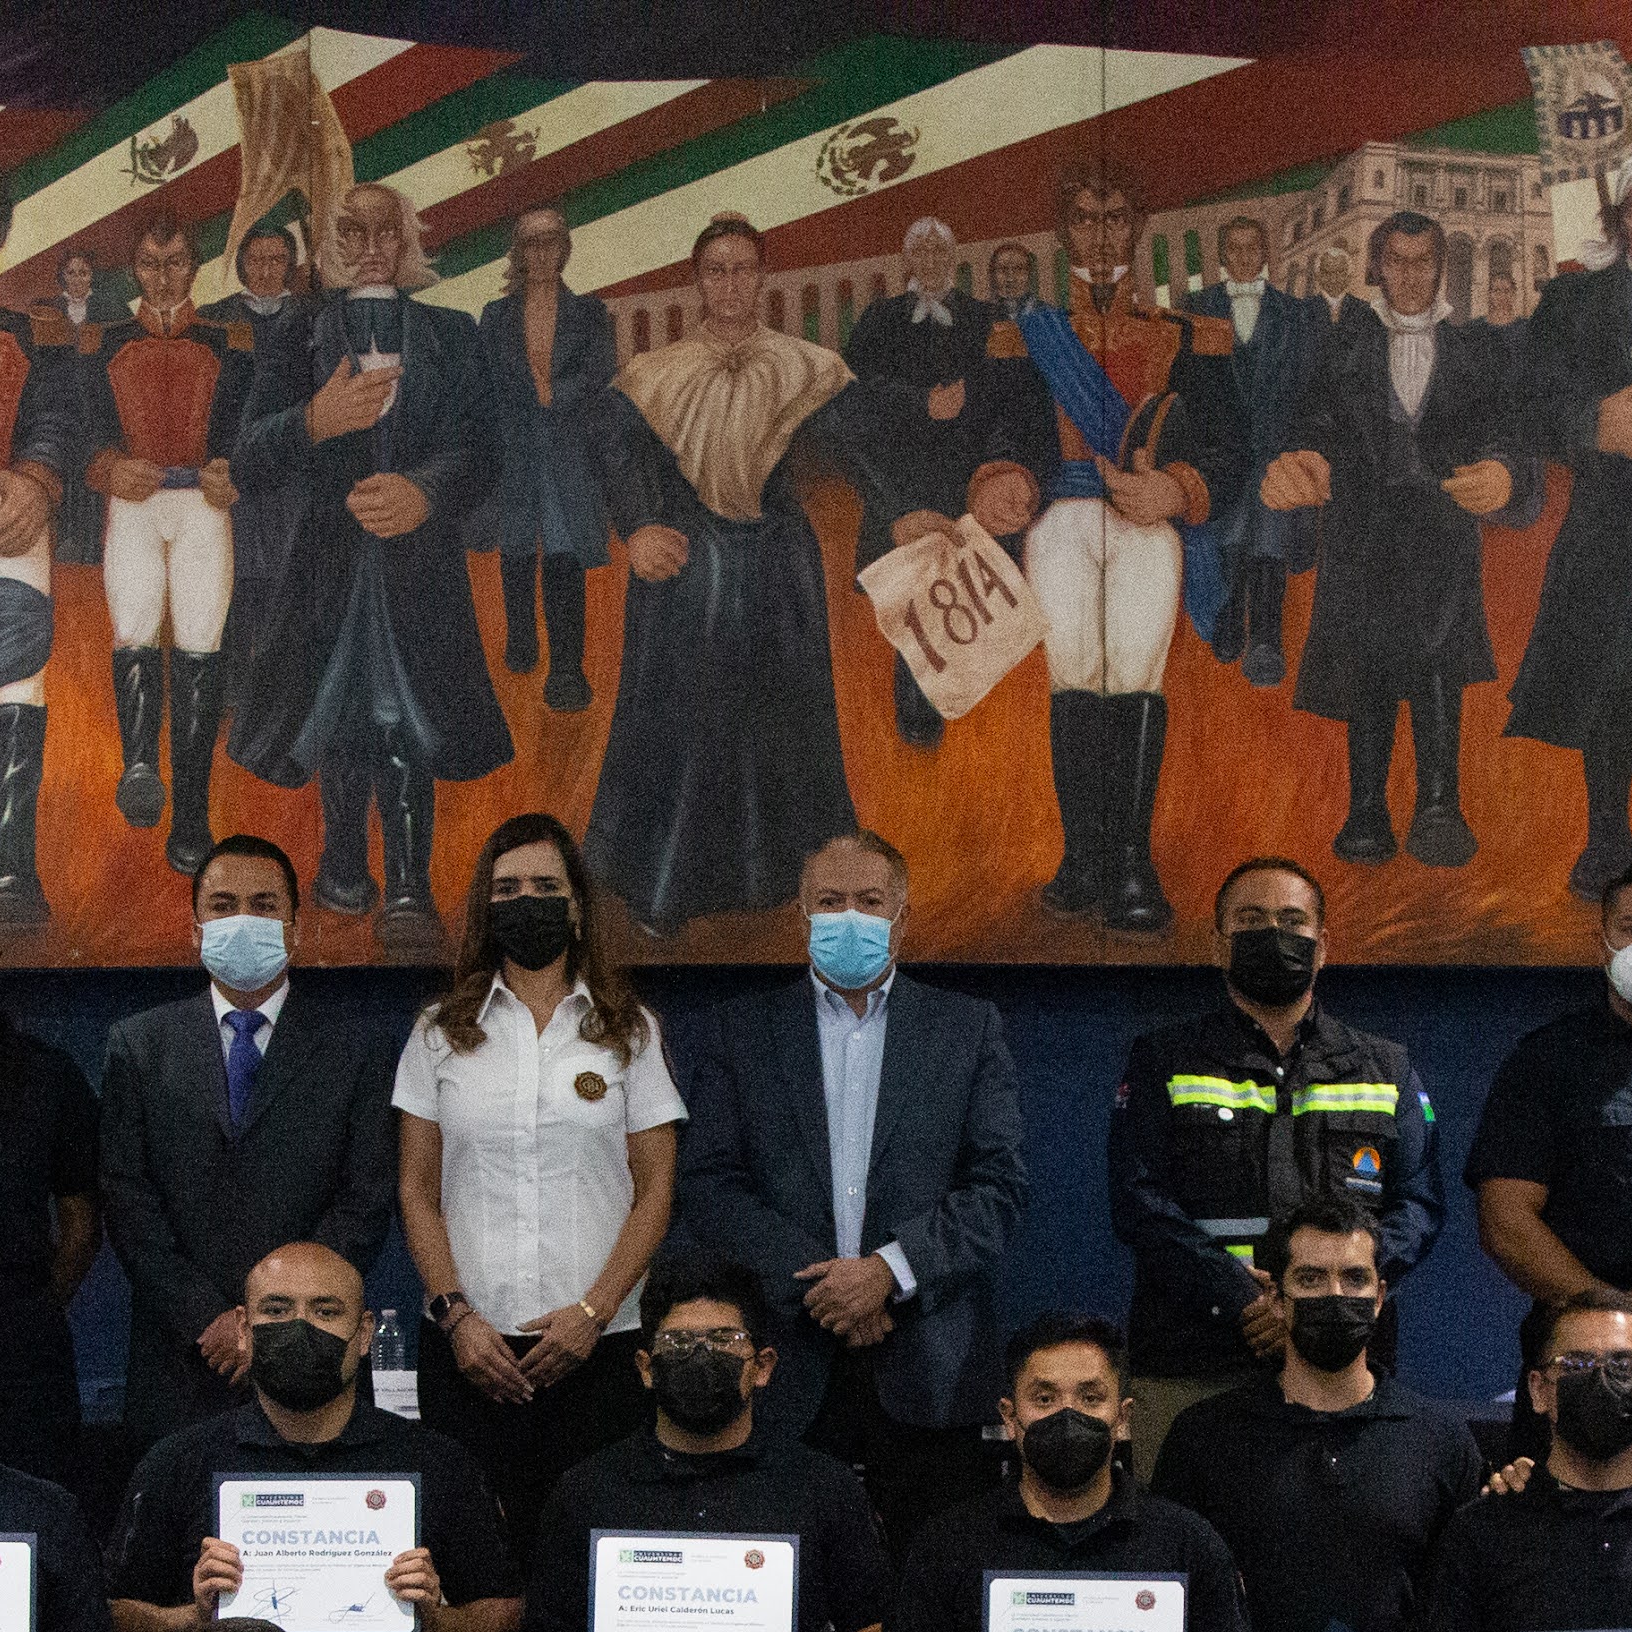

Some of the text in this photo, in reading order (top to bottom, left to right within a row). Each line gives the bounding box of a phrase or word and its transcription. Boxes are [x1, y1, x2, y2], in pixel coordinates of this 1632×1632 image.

[242, 1530, 380, 1545] CONSTANCIA
[276, 1549, 306, 1557] Alberto
[354, 1549, 392, 1557] González
[618, 1585, 759, 1604] CONSTANCIA
[630, 1605, 646, 1613] Eric
[648, 1605, 668, 1613] Uriel
[670, 1606, 708, 1614] Calderón
[710, 1607, 735, 1615] Lucas
